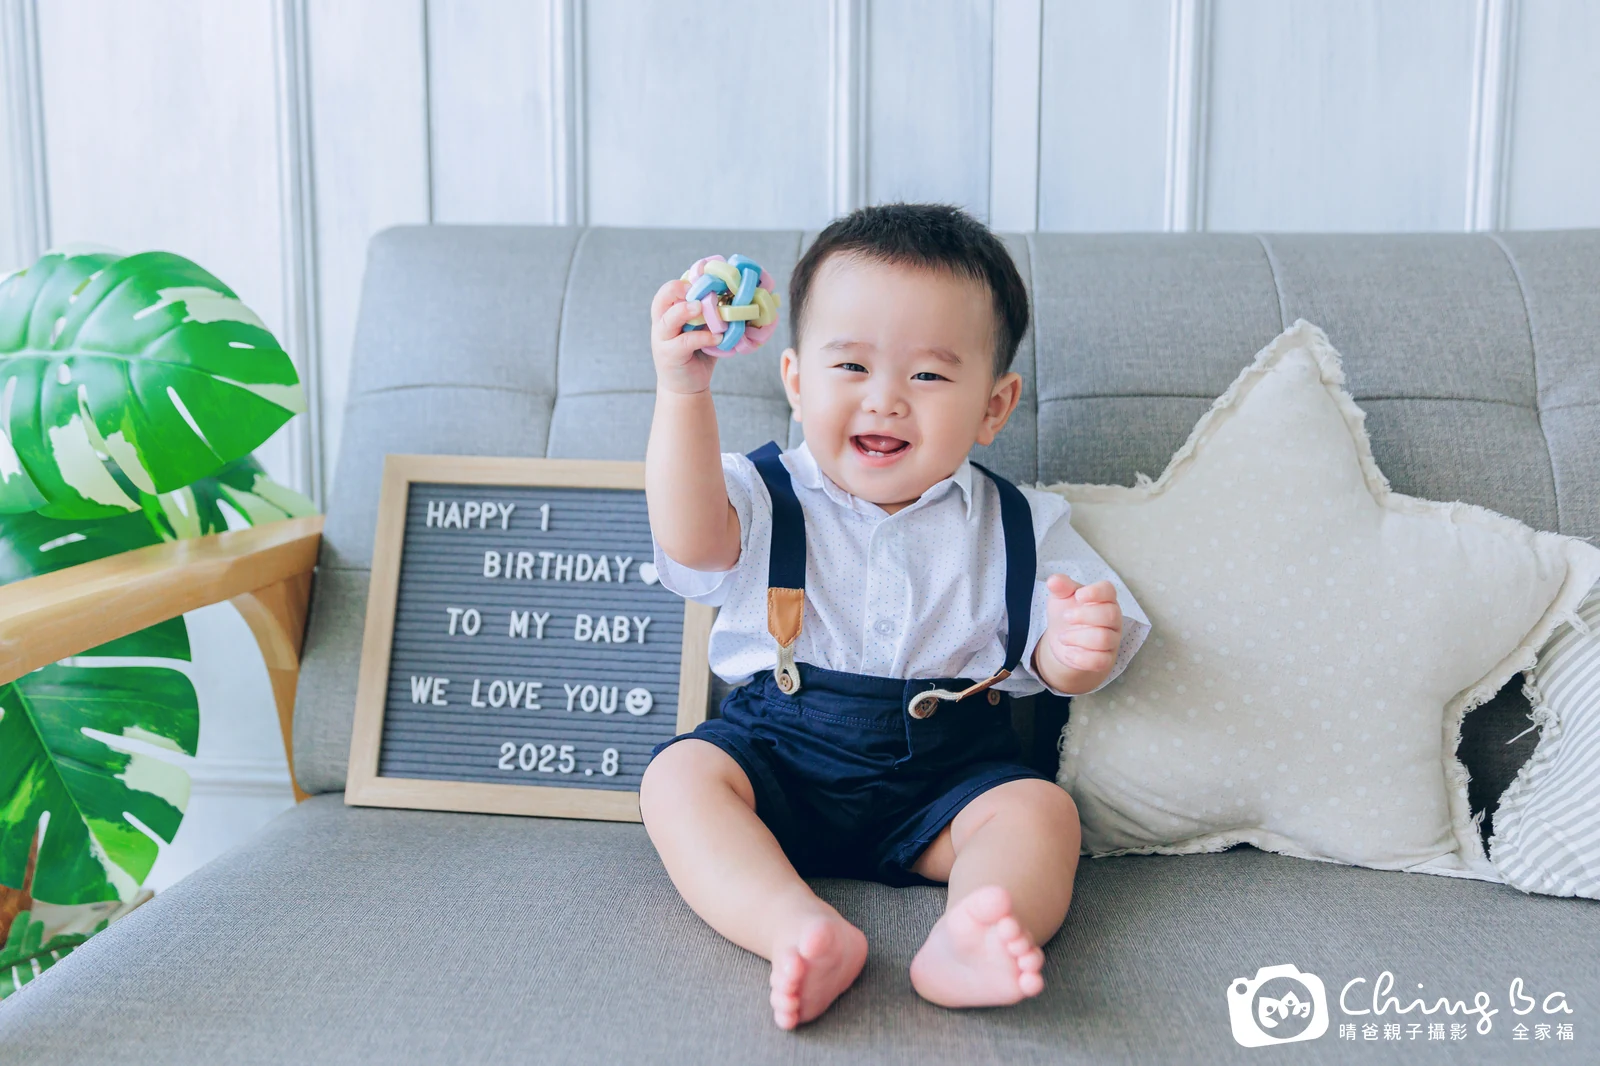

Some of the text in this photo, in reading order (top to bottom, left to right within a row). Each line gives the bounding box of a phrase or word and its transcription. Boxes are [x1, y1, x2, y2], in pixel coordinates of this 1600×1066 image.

[426, 500, 550, 532] HAPPY 1
[483, 550, 633, 584] BIRTHDAY
[446, 607, 651, 644] TO MY BABY
[410, 675, 618, 714] WE LOVE YOU
[498, 742, 619, 777] 2025.8
